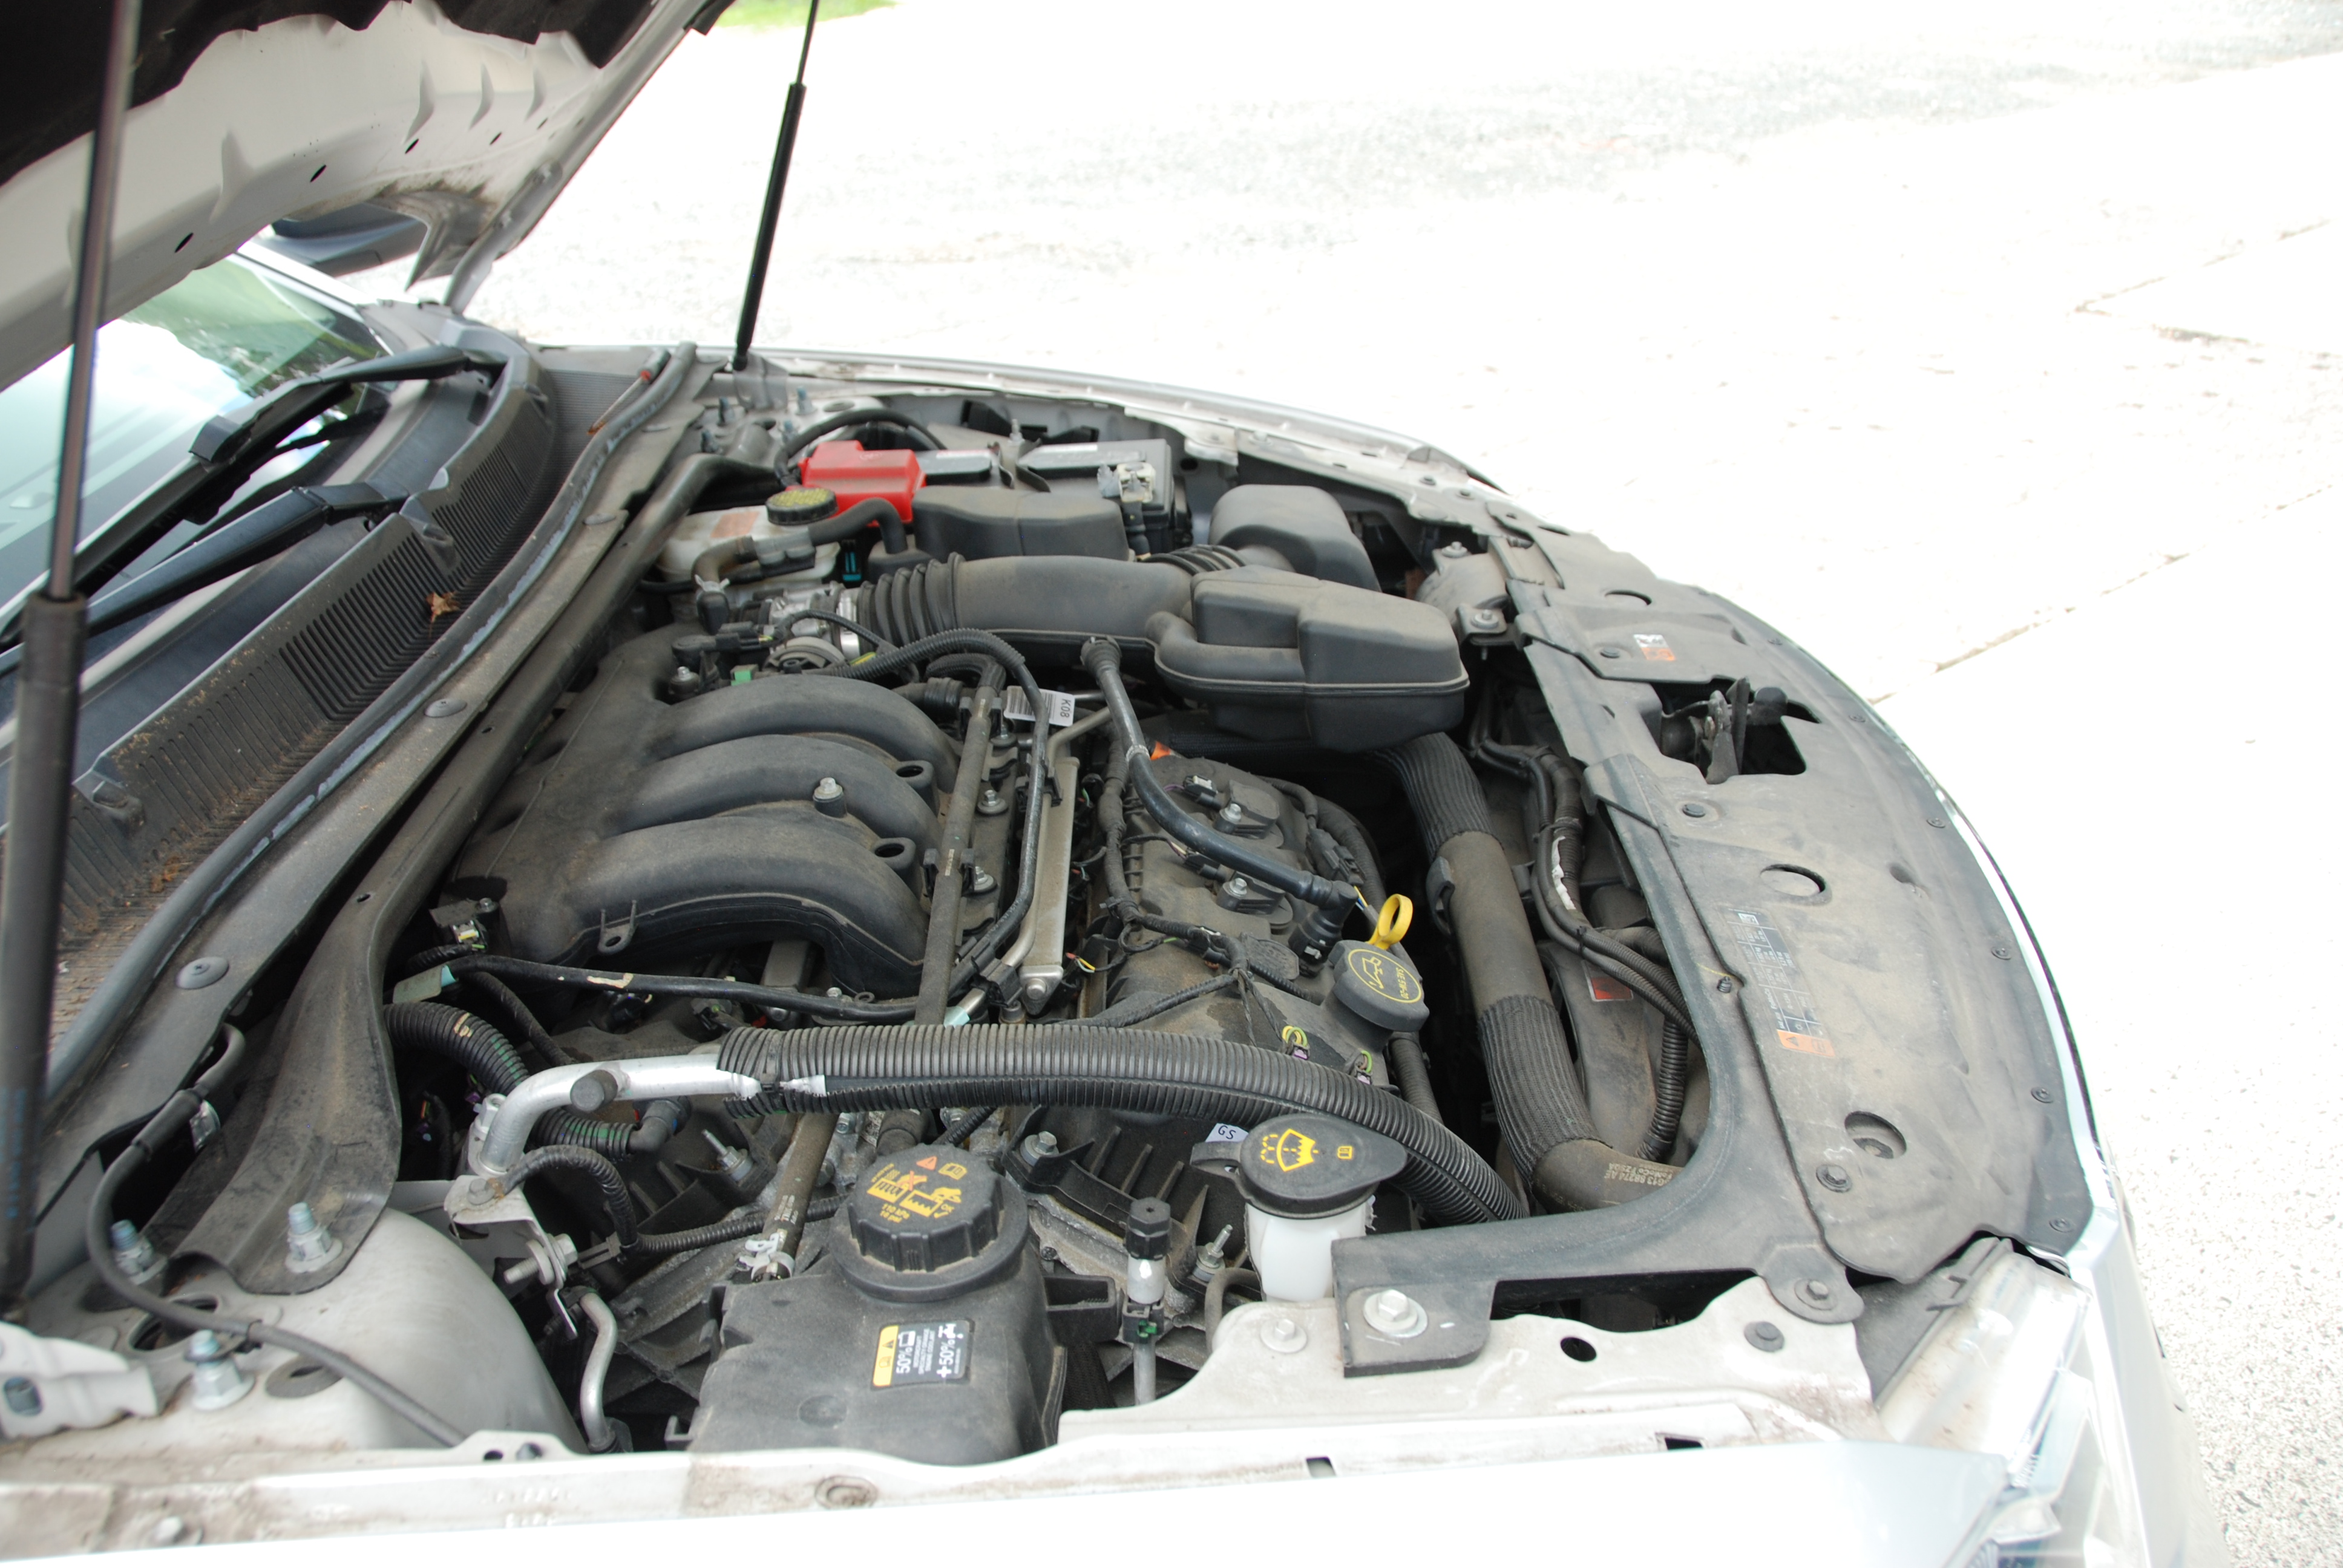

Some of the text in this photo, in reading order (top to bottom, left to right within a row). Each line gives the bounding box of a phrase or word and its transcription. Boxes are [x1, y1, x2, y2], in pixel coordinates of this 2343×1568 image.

[1060, 698, 1072, 718] K08
[1395, 967, 1409, 999] SAE 5W-20
[1218, 1125, 1237, 1140] GS
[941, 1204, 955, 1214] OK
[896, 1347, 913, 1374] 50%
